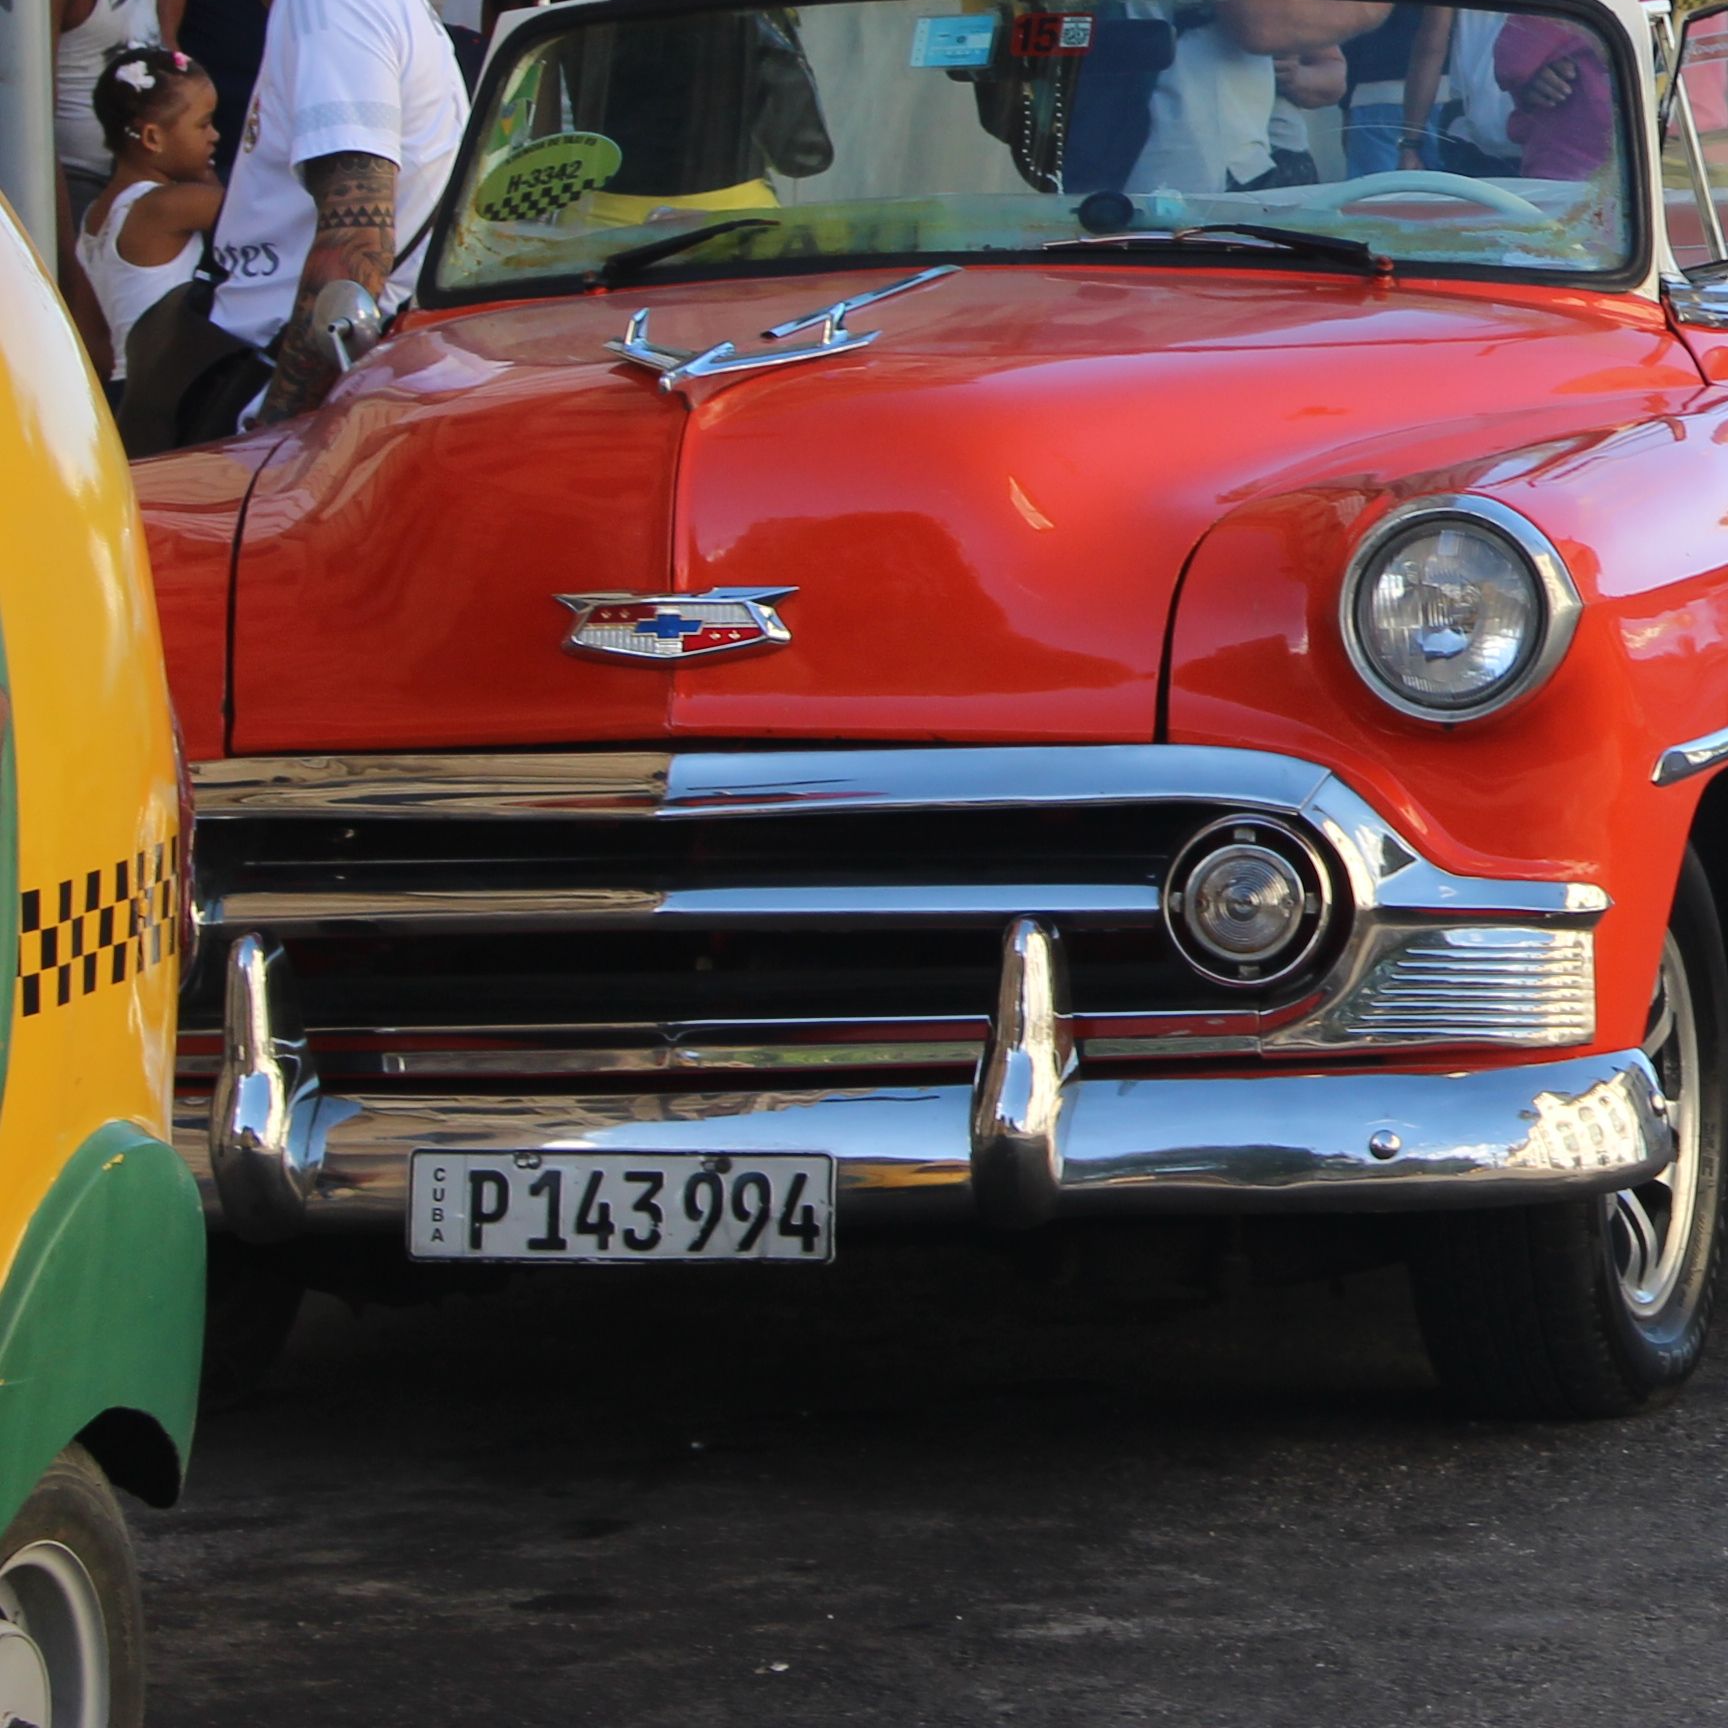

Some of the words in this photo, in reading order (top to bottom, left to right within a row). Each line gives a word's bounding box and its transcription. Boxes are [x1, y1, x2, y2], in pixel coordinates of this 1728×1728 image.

[1017, 16, 1059, 52] 15
[506, 160, 583, 194] H-3342
[431, 1167, 446, 1243] CUBA
